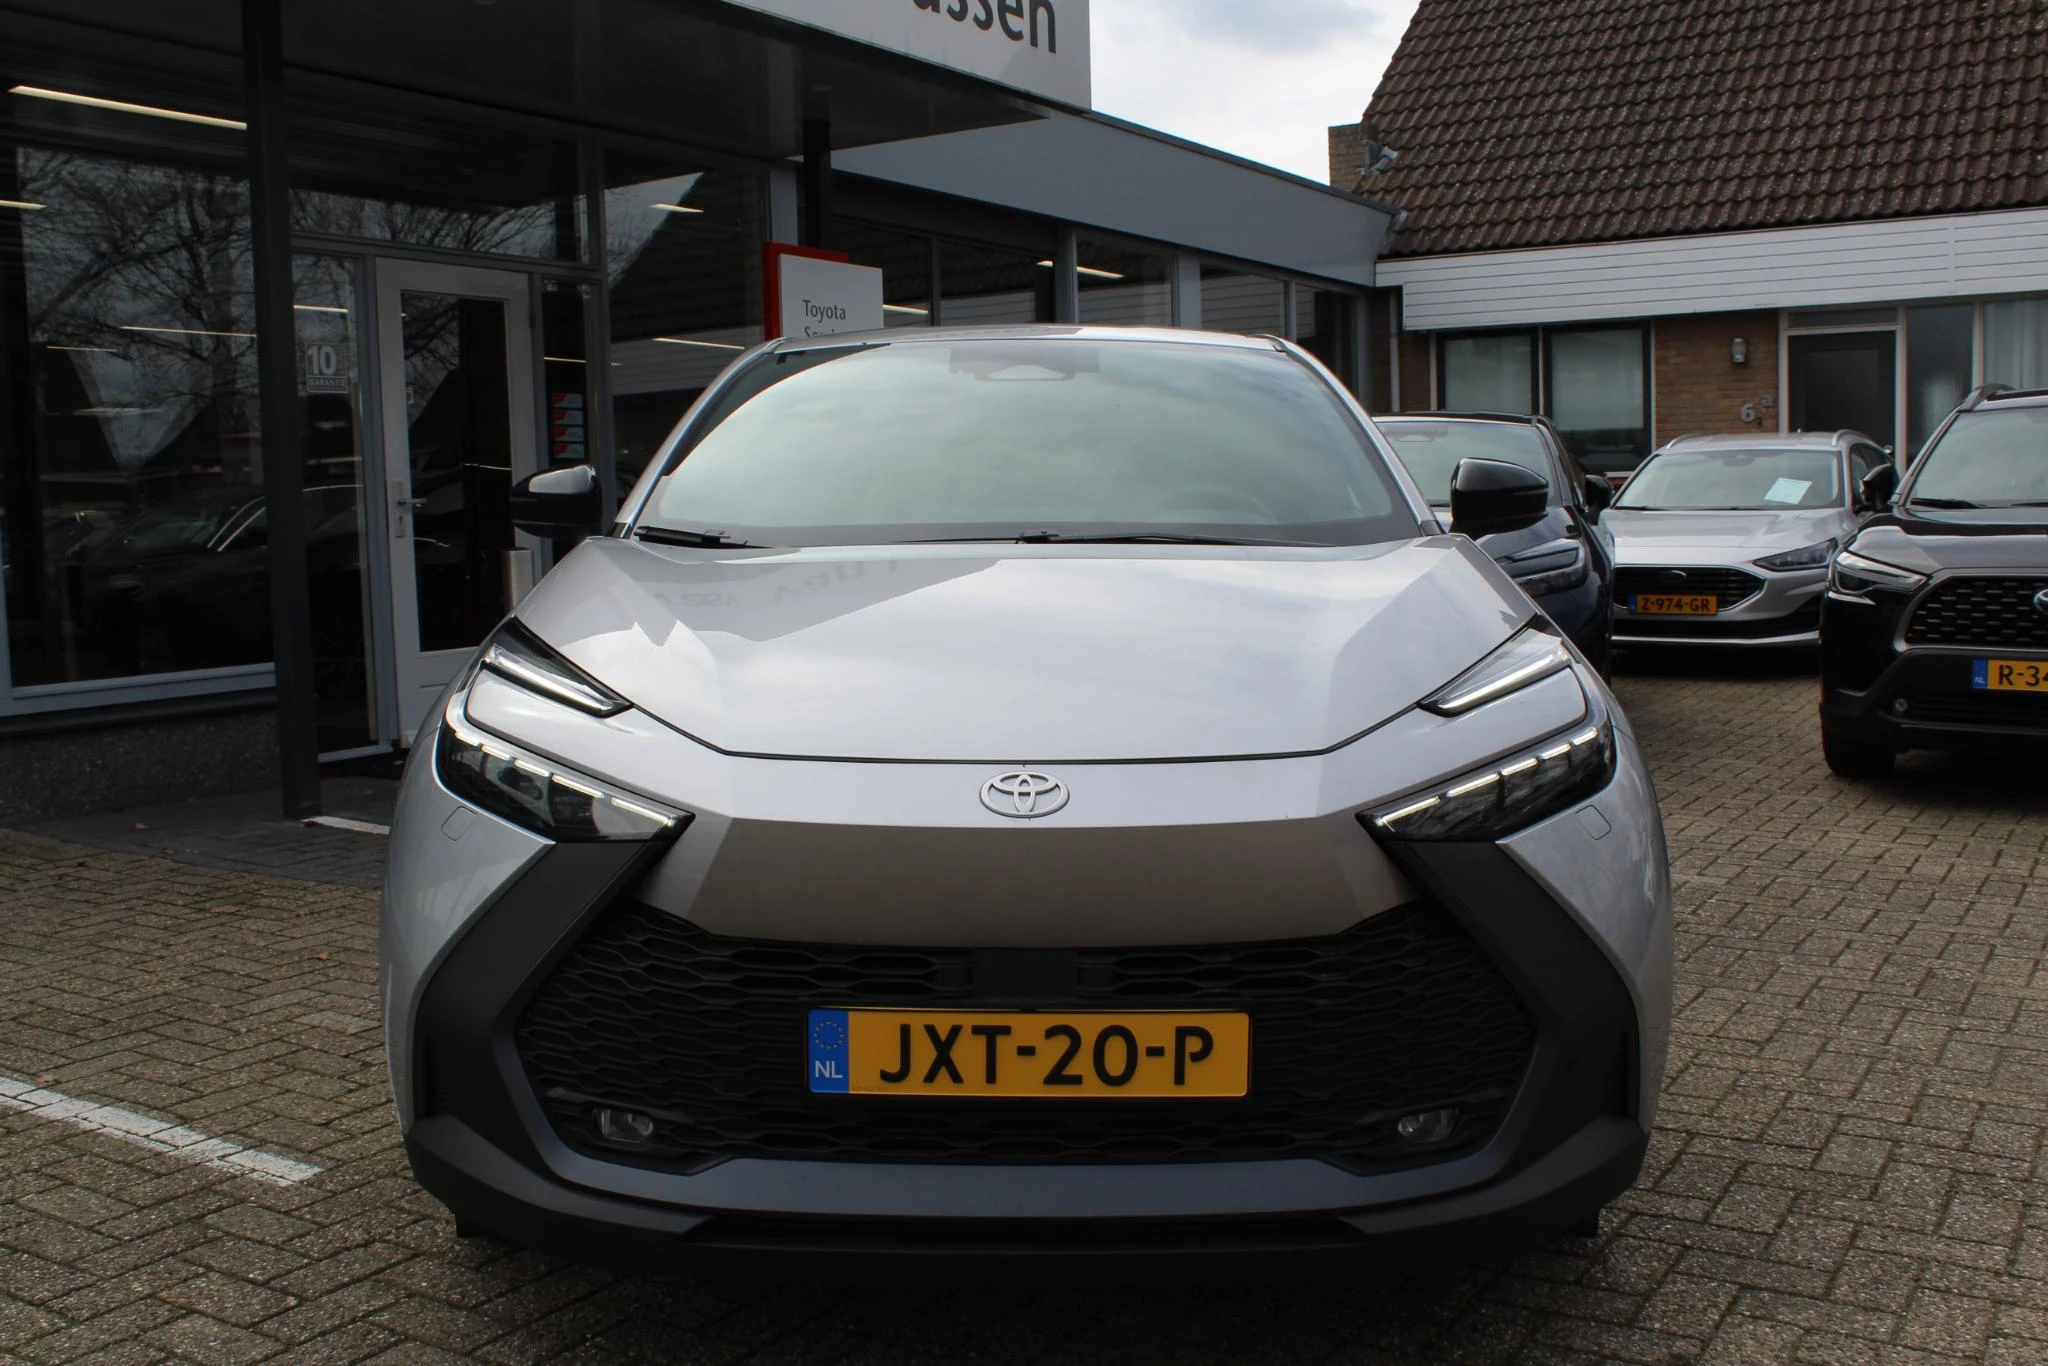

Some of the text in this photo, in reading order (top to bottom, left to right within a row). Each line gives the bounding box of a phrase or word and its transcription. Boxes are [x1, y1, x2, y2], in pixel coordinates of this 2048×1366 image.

[912, 0, 1056, 54] sen
[802, 299, 846, 323] Toyota
[307, 345, 337, 376] 10
[1740, 403, 1755, 422] 6
[1641, 598, 1710, 612] Z-974-GR
[879, 1023, 1215, 1087] JXT-20-P
[815, 1060, 843, 1079] NL
